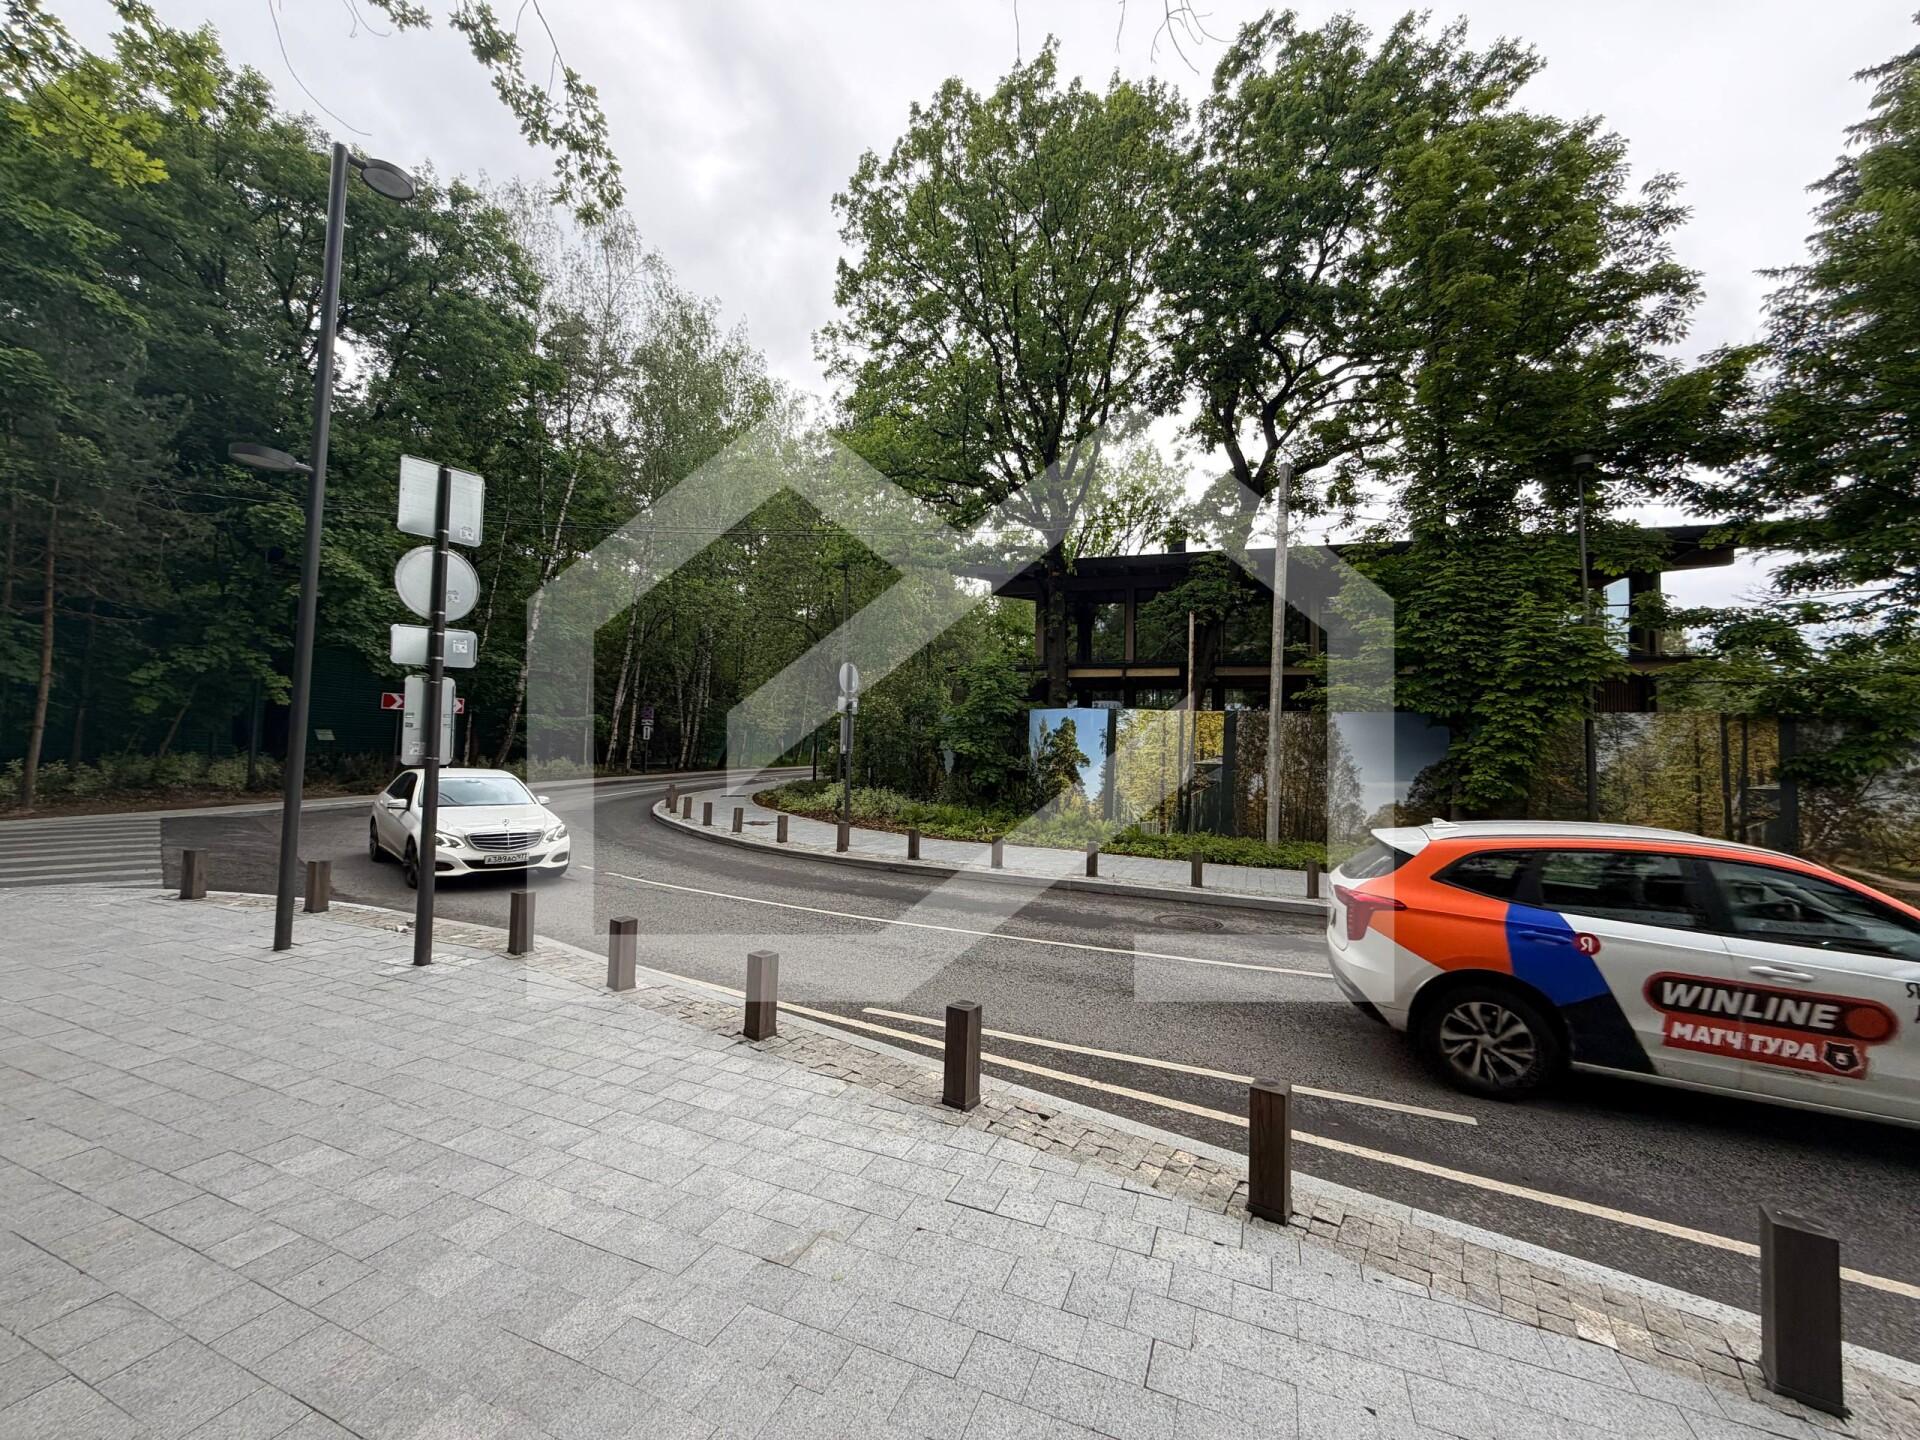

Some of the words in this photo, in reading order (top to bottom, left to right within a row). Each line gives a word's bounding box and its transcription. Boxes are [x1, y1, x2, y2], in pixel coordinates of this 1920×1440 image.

[1580, 936, 1593, 952] Я
[1662, 981, 1840, 1030] WINLINE
[1670, 1021, 1743, 1050] МАТЧ
[1748, 1033, 1818, 1062] ТУРА
